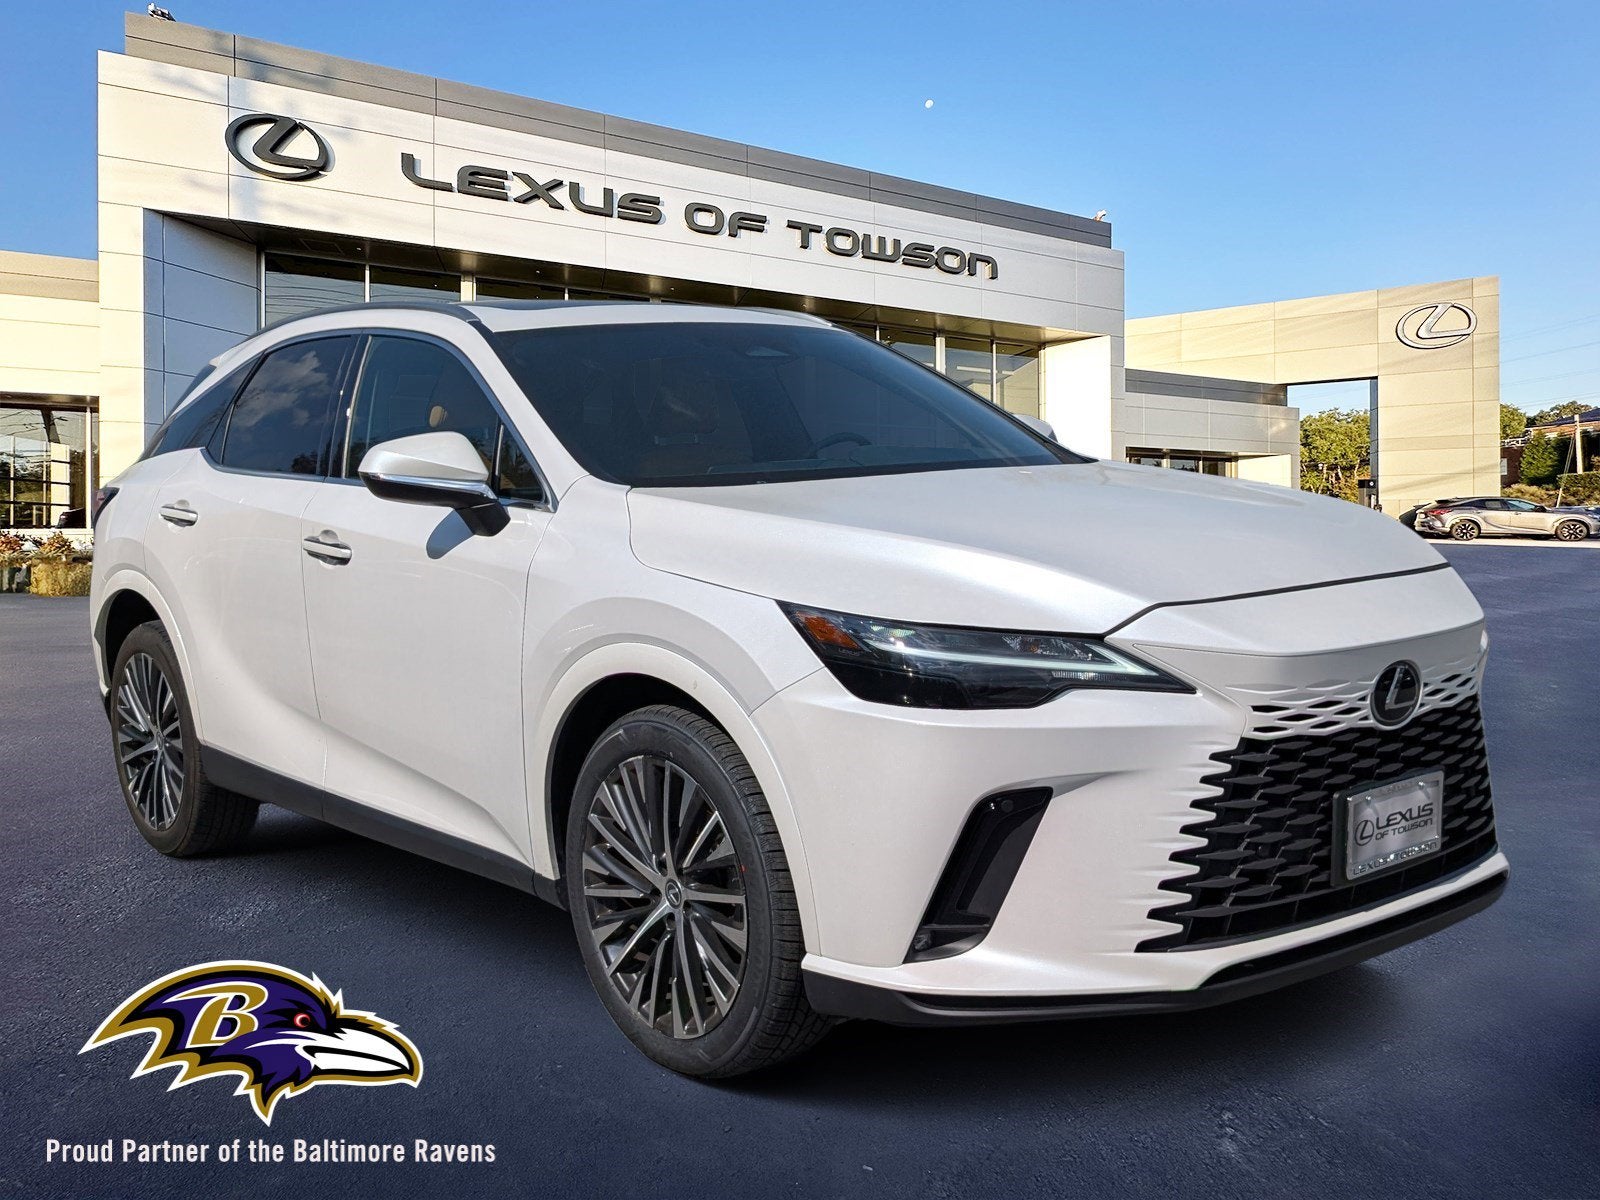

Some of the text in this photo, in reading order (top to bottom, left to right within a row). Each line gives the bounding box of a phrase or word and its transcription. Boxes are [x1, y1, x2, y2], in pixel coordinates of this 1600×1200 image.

[401, 152, 999, 280] LEXUS OF TOWSON
[1375, 803, 1434, 830] LEXUS
[1375, 817, 1433, 841] OF TOWSON
